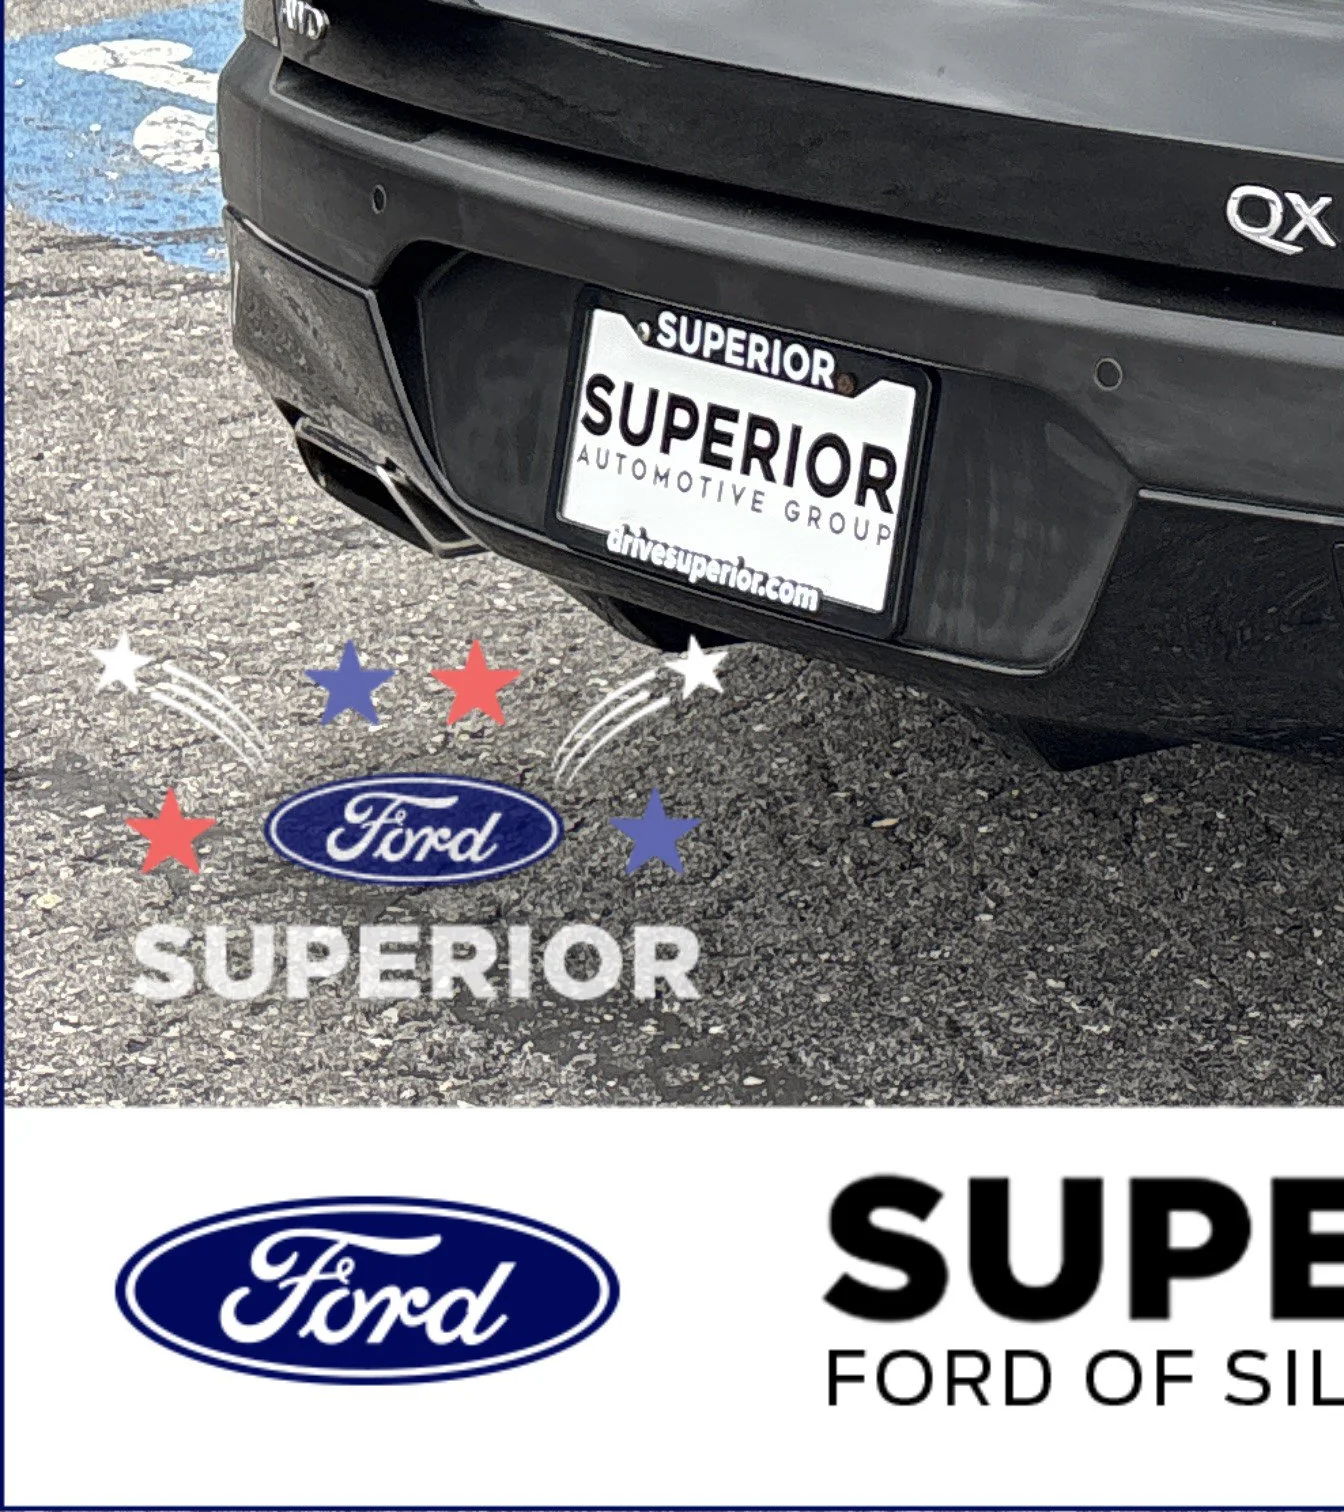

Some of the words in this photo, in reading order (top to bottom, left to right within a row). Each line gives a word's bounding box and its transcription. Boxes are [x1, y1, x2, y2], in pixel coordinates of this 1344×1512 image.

[656, 310, 837, 390] SUPERIOR
[580, 372, 898, 515] SUPERIOR
[576, 444, 766, 514] AUTOMOTIVE
[784, 498, 893, 546] GROUP
[606, 525, 821, 612] drivesuperior.com
